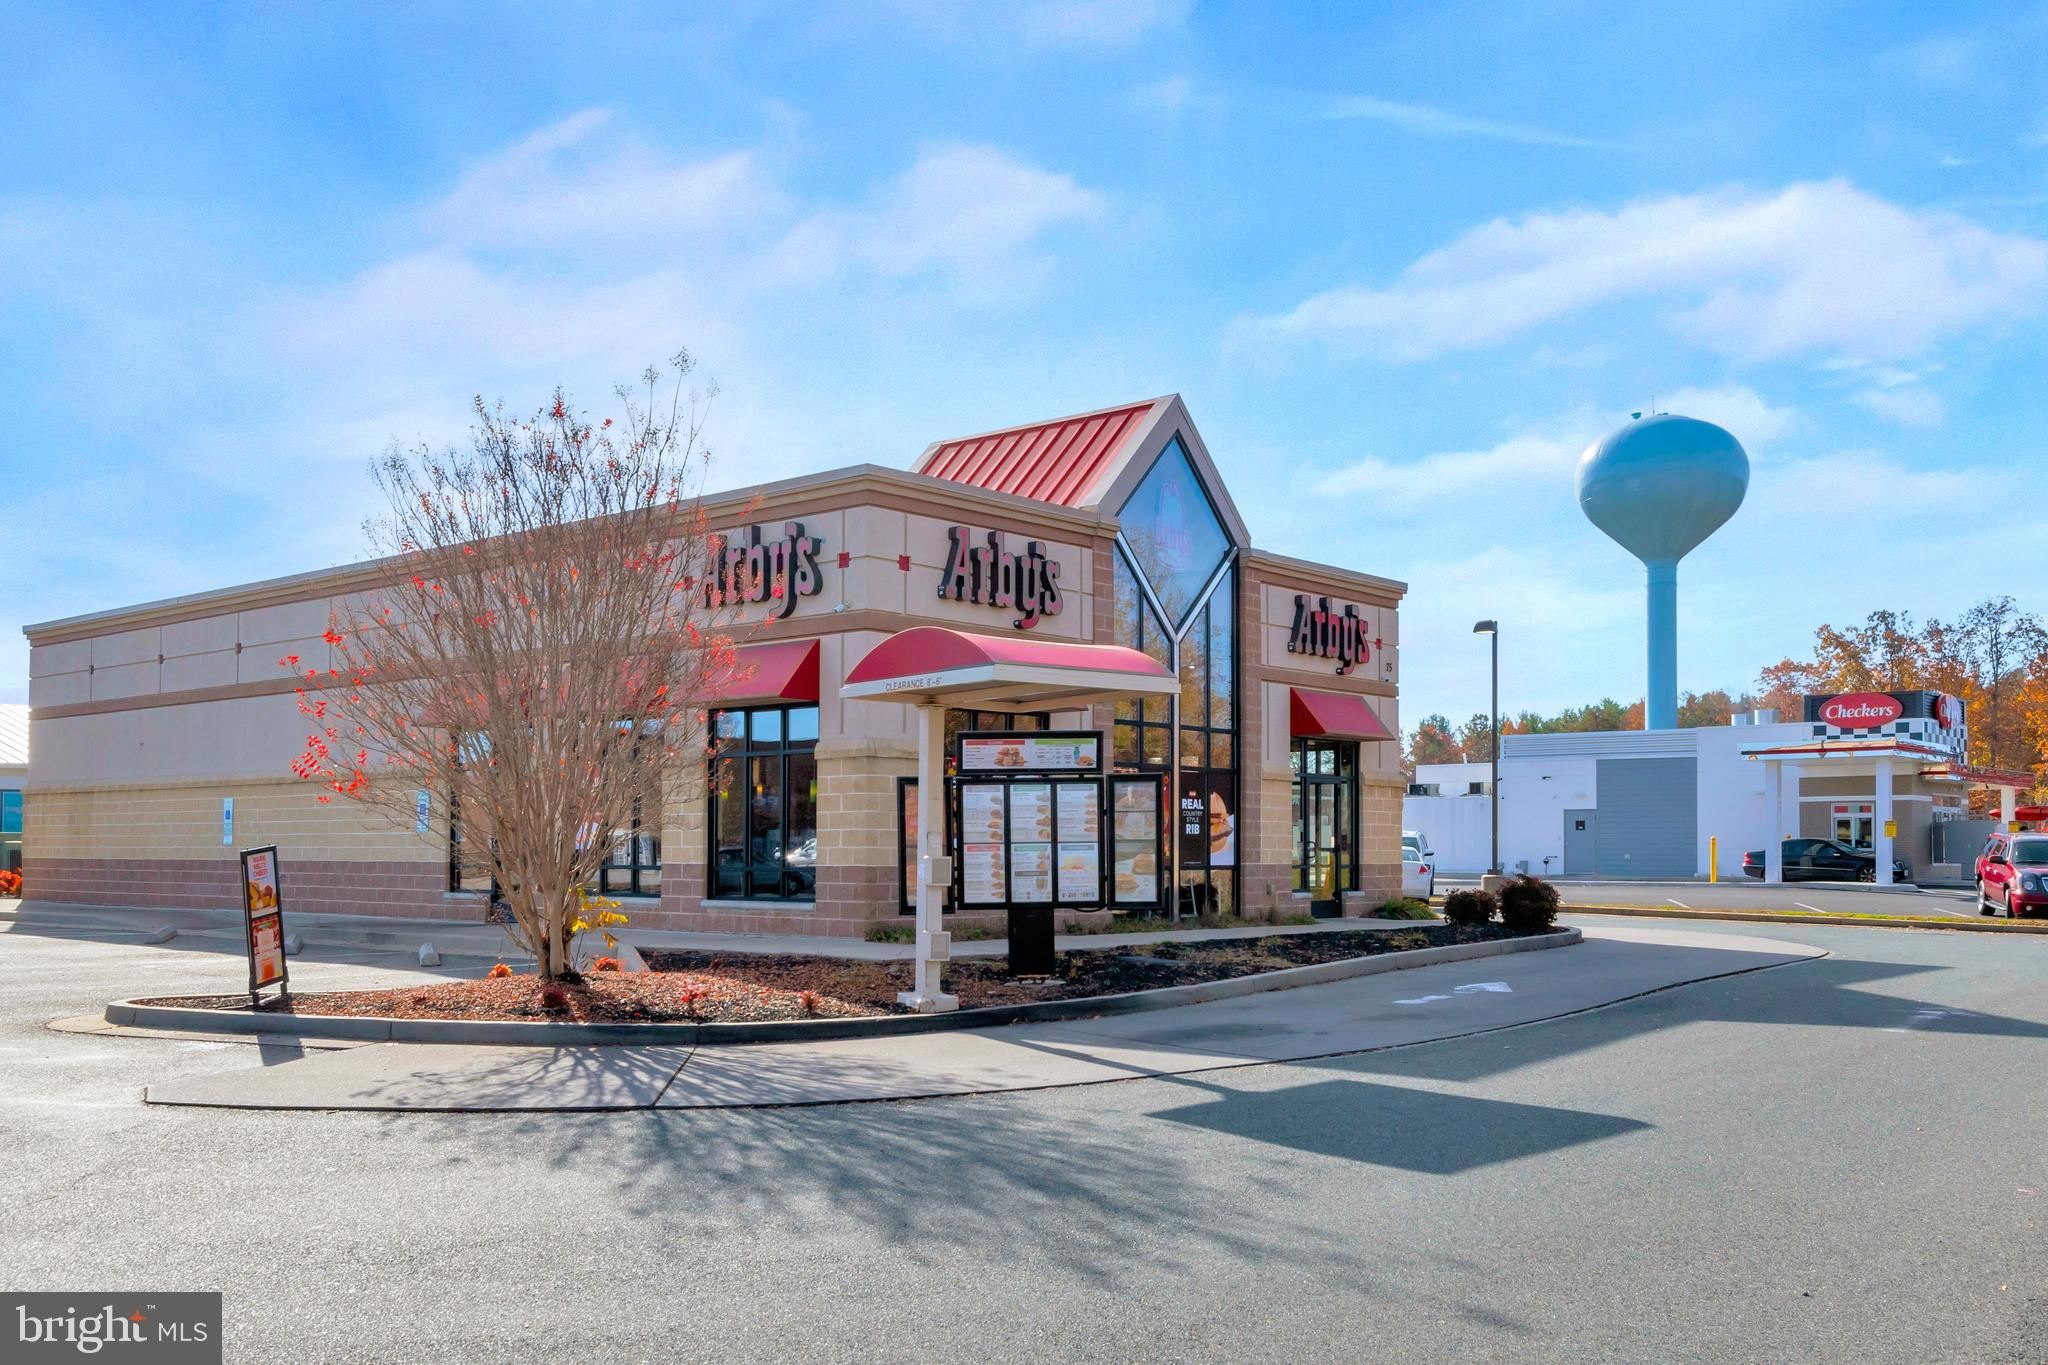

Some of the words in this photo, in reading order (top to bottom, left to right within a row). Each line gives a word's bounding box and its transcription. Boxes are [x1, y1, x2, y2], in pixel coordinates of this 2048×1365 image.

[699, 521, 823, 619] Arby's
[938, 526, 1063, 629] Arby's
[1287, 595, 1370, 675] Arby's
[886, 679, 924, 691] CLEARANCE
[1825, 703, 1893, 719] Checkers
[1181, 799, 1204, 809] REAL
[1185, 824, 1200, 834] RIB
